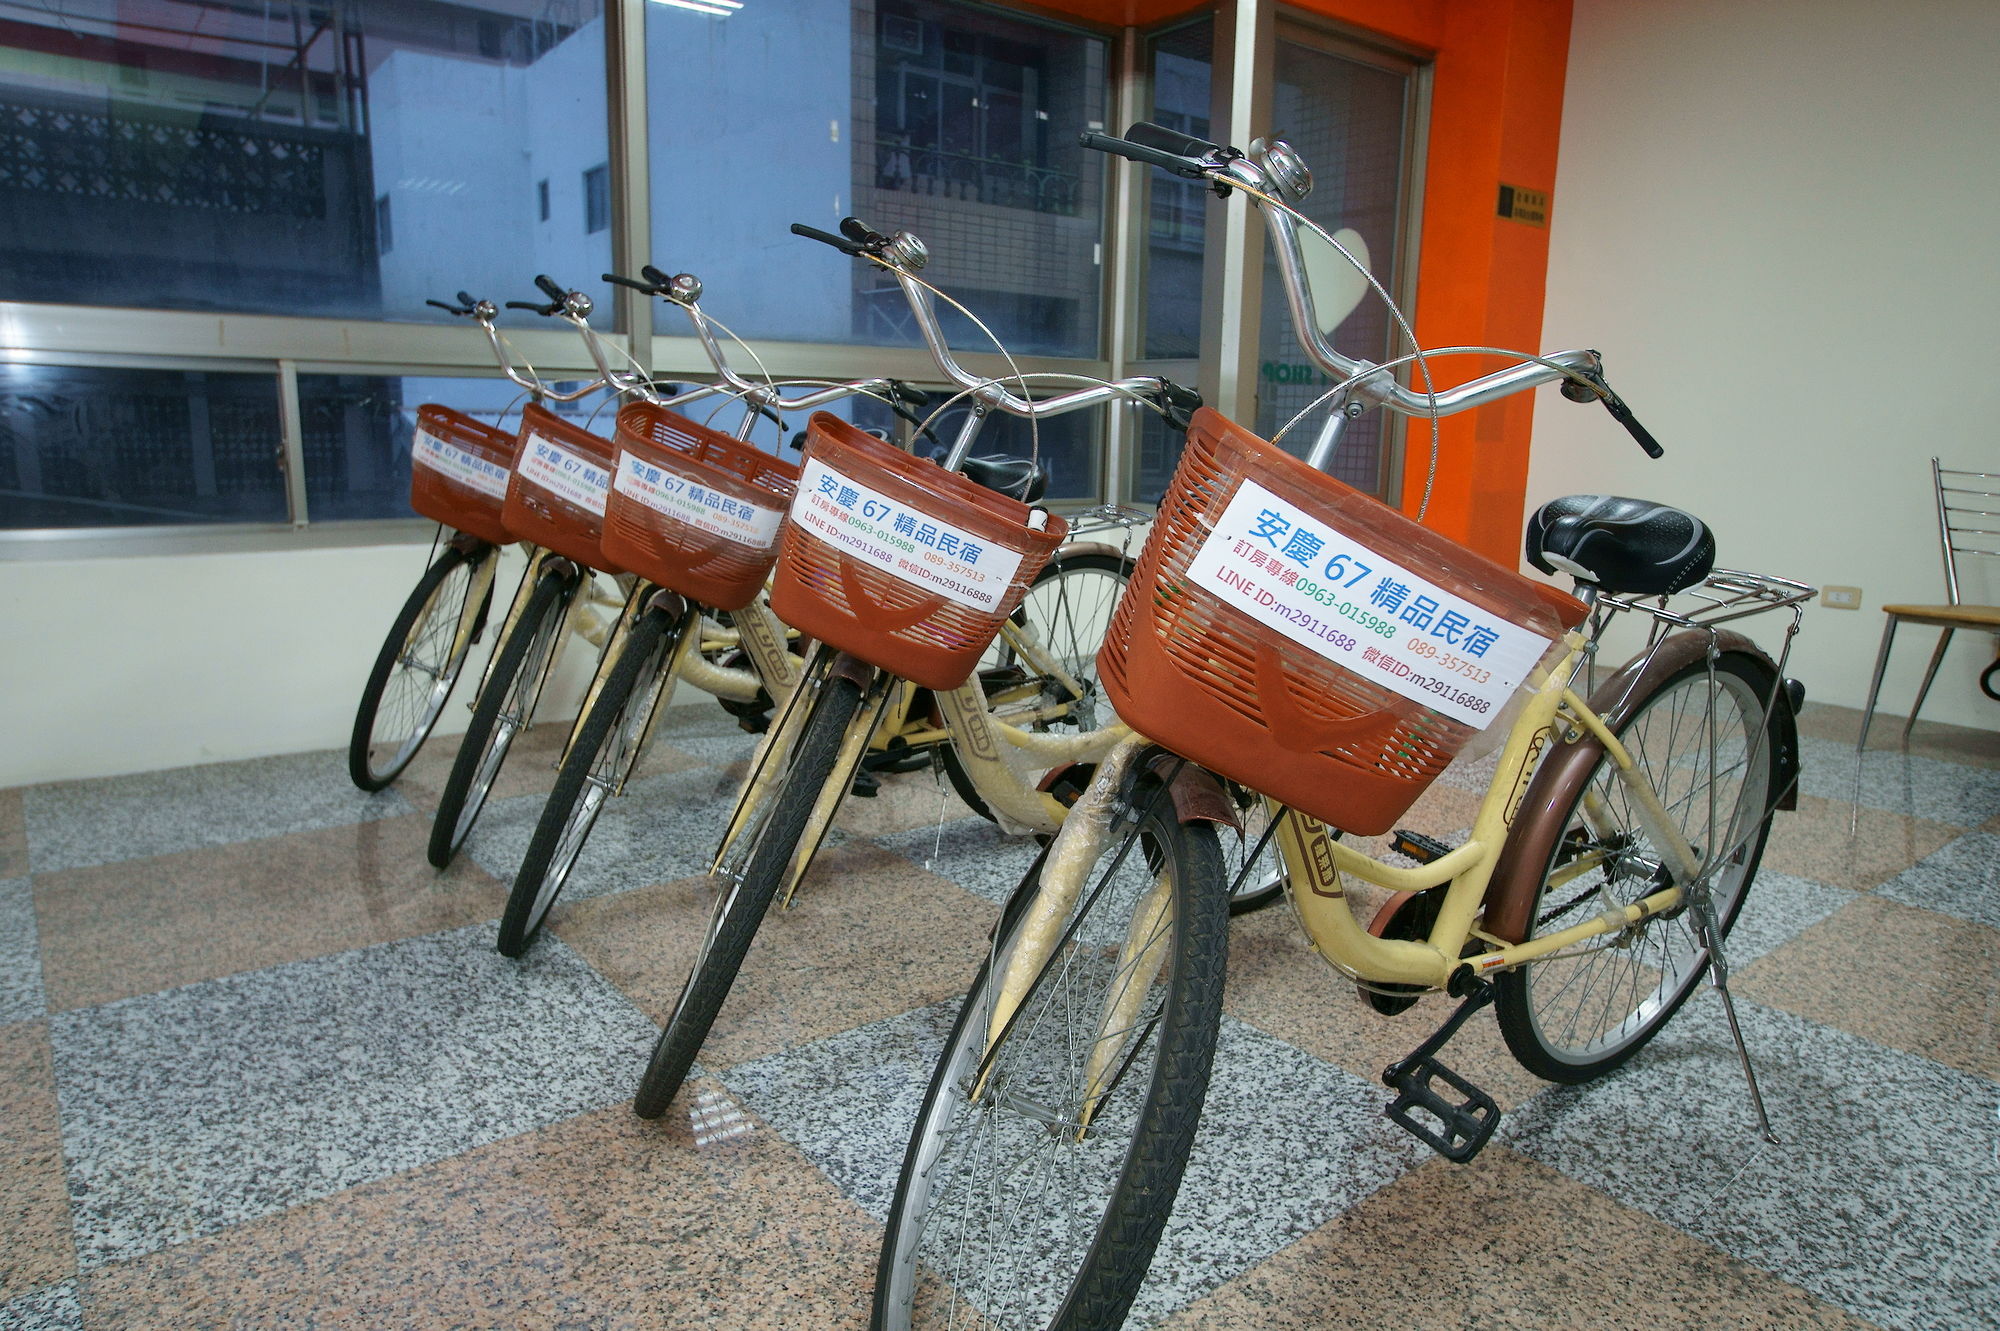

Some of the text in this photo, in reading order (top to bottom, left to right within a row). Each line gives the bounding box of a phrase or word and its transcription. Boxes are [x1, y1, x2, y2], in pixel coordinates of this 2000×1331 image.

[564, 459, 581, 473] 67
[665, 477, 685, 493] 67
[688, 485, 755, 521] 精品民宿
[804, 510, 993, 604] LINE ID:m2911688 微信ID:m29116888
[811, 494, 986, 583] 訂房專線0963-015988 089-357513
[817, 474, 983, 565] 安慶 67 精品民宿
[1232, 538, 1492, 685] 訂房專線0963-015988 089-357513
[1248, 508, 1500, 659] 安慶 67 精品民宿
[1216, 565, 1492, 714] LINE ID:m2911688 微信ID:m29116888
